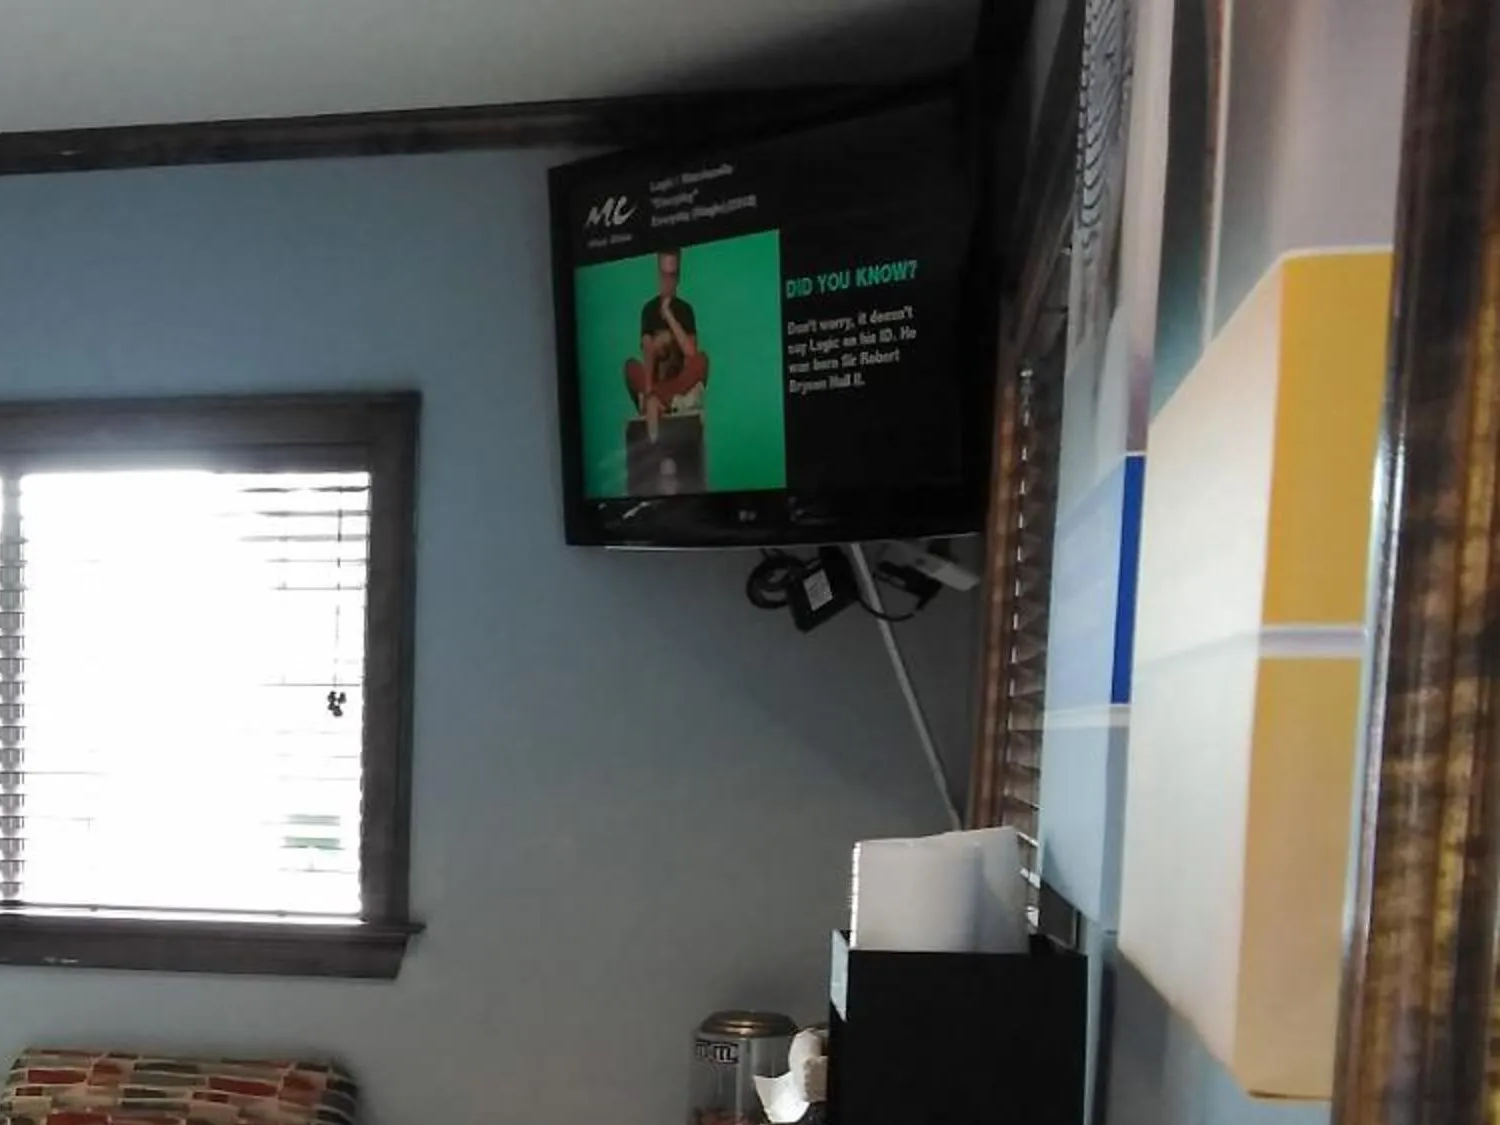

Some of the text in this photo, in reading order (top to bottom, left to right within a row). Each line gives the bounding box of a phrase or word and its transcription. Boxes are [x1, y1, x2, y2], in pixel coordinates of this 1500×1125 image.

[786, 259, 917, 299] DID YOU KNOW?
[788, 320, 817, 335] Don't
